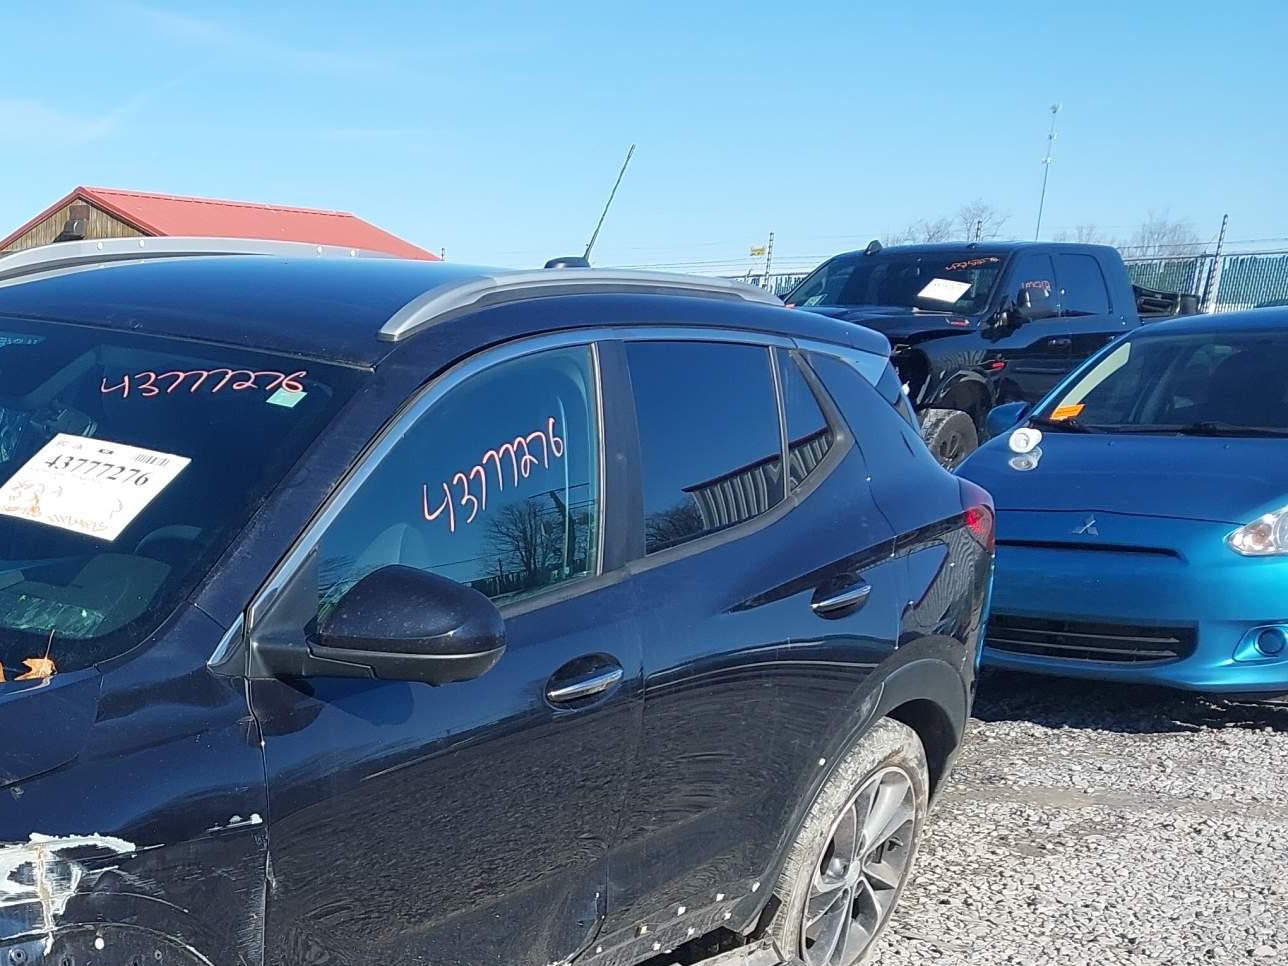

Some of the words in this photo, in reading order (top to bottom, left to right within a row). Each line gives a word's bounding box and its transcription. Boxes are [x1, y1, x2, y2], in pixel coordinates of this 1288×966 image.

[100, 370, 307, 398] 43777276
[44, 454, 150, 487] 43777276
[423, 417, 565, 533] 43777276
